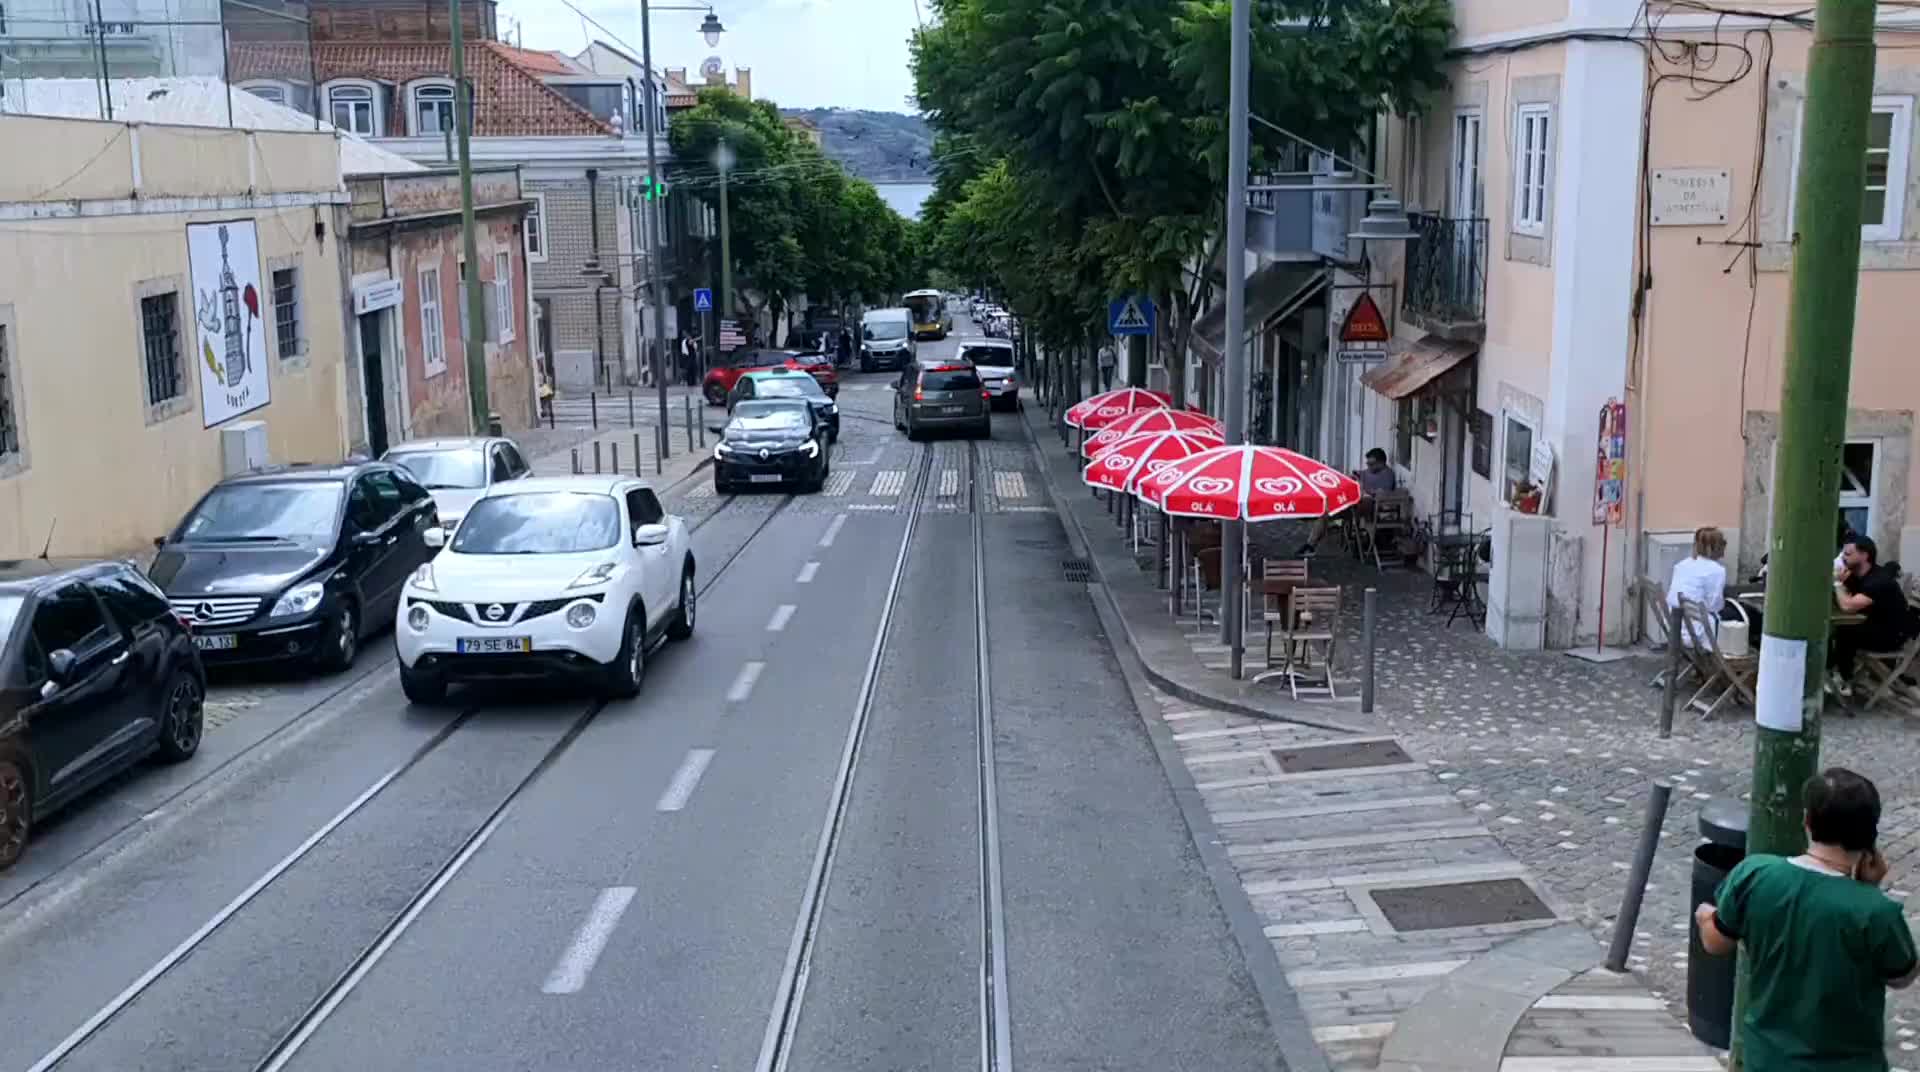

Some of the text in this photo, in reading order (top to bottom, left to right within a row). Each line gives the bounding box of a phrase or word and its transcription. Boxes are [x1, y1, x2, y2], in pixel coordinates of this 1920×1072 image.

[1191, 499, 1214, 512] OLÁ
[1273, 499, 1295, 512] OLÁ
[466, 639, 481, 651] 79
[484, 639, 502, 650] SE
